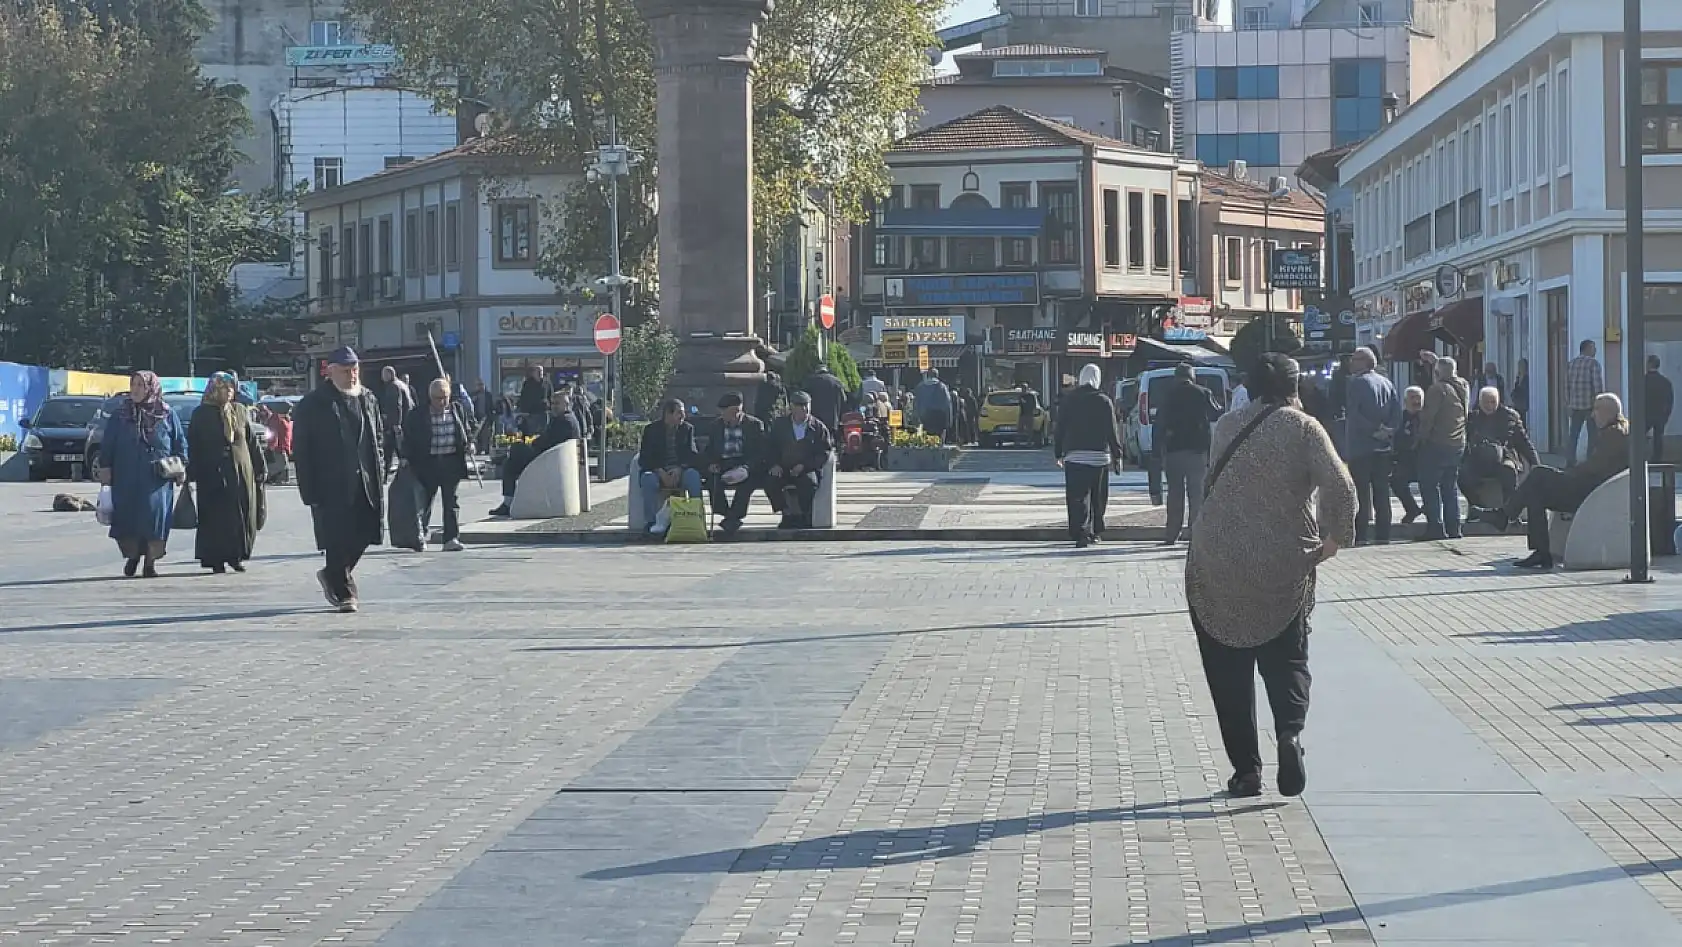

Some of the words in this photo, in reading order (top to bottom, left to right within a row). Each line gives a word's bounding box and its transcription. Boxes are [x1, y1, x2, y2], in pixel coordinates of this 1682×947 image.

[1279, 265, 1313, 273] KIYAK
[498, 311, 577, 331] ekomini
[884, 318, 951, 328] SAATHANE
[1007, 329, 1057, 341] SAATHANE
[1067, 333, 1103, 346] SAATHANE
